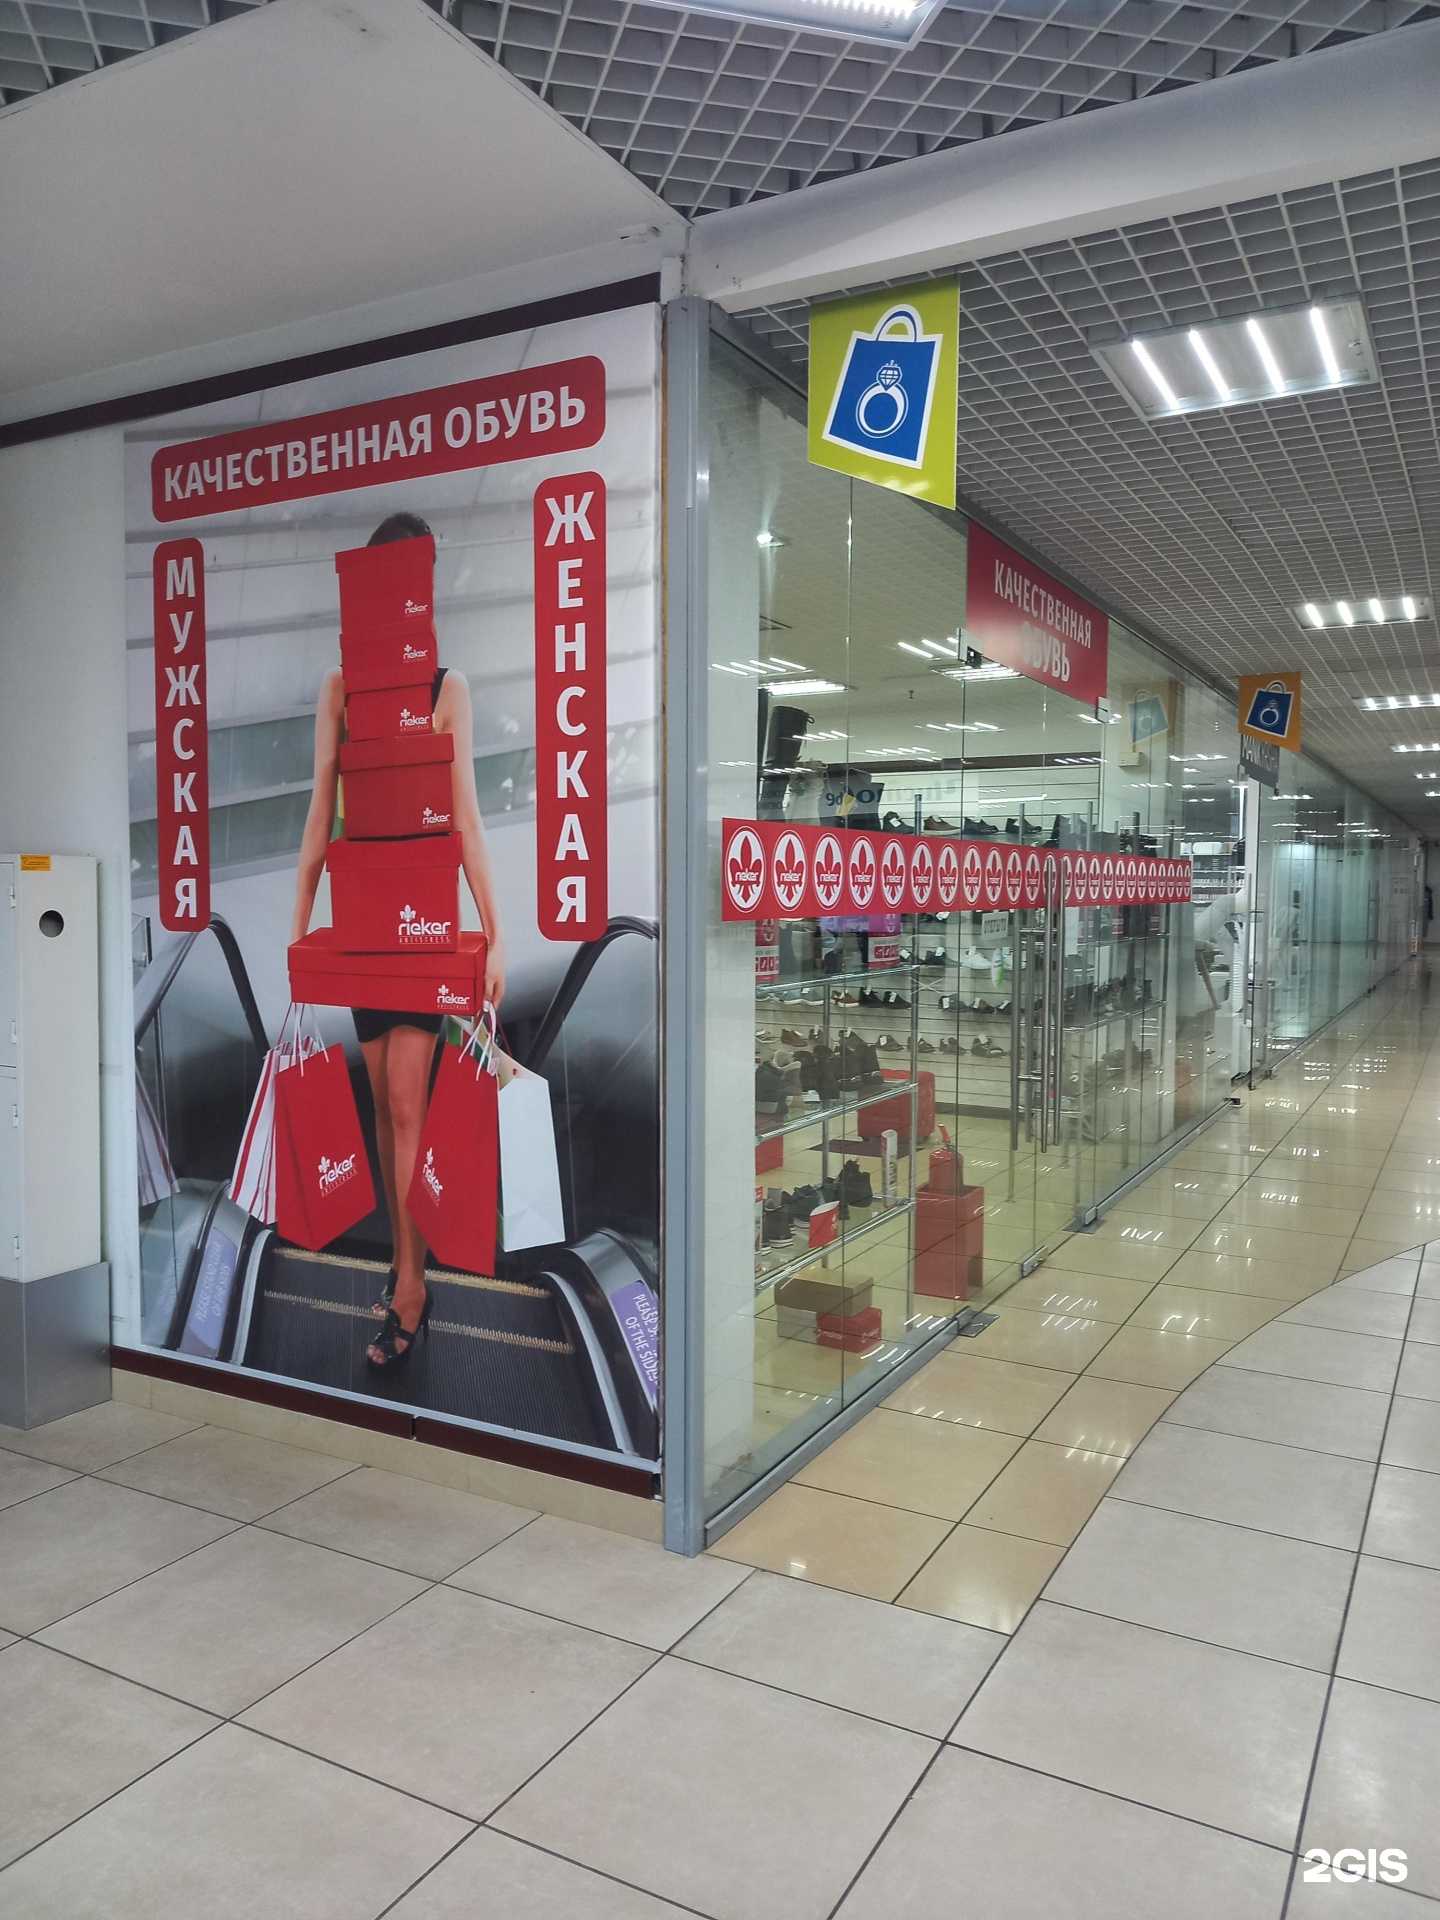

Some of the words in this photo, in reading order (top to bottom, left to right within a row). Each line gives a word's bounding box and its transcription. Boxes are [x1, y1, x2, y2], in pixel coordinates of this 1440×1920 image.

[164, 414, 432, 502] КАЧЕСТВЕННАЯ
[444, 385, 586, 449] ОБУВЬ
[994, 559, 1092, 649] КАЧЕСТВЕННАЯ
[1023, 620, 1071, 682] ОБУВЬ
[544, 491, 595, 923] ЖЕНСКАЯ
[165, 556, 202, 918] МУЖСКАЯ
[398, 917, 452, 936] rieker
[437, 993, 471, 1005] rieker
[319, 1153, 356, 1190] rieker
[624, 1315, 642, 1330] OF
[630, 1326, 650, 1351] THE
